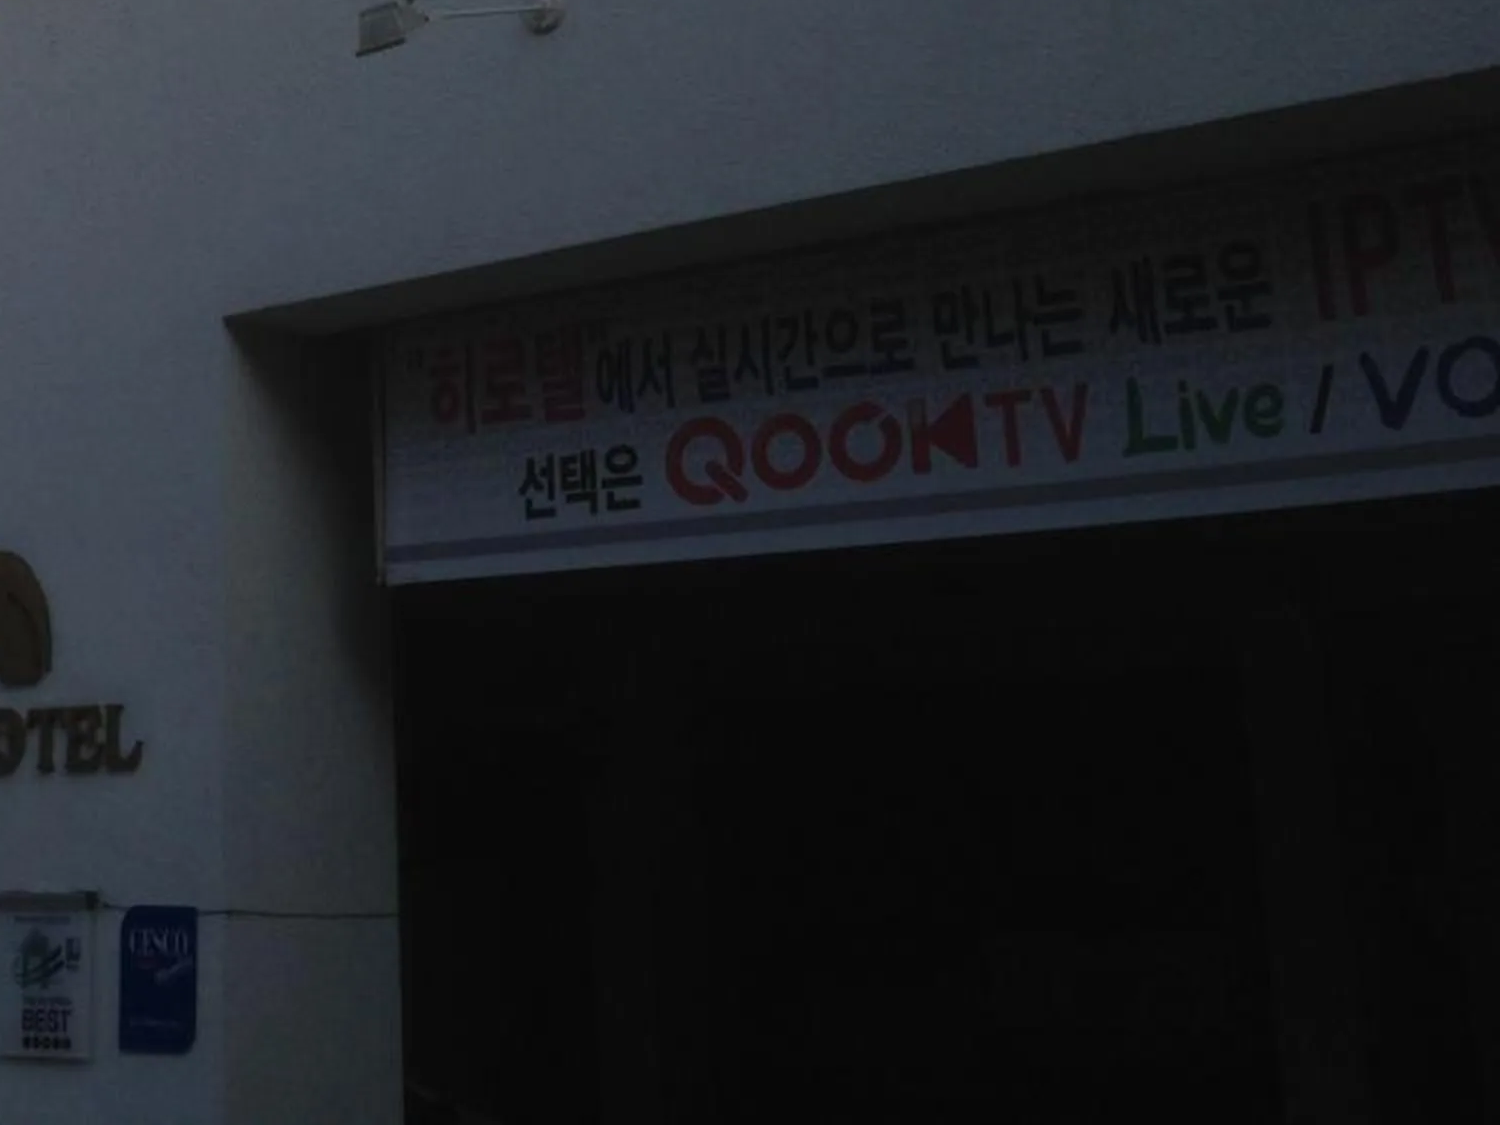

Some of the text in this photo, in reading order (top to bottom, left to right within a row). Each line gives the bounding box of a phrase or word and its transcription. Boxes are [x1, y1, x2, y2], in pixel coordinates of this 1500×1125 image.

[690, 303, 917, 404] 실시간으로
[933, 277, 1086, 371] 만나는
[1109, 239, 1274, 347] 새로운
[519, 443, 643, 521] 선택은
[1121, 376, 1285, 457] Live
[21, 1008, 73, 1033] BEST
